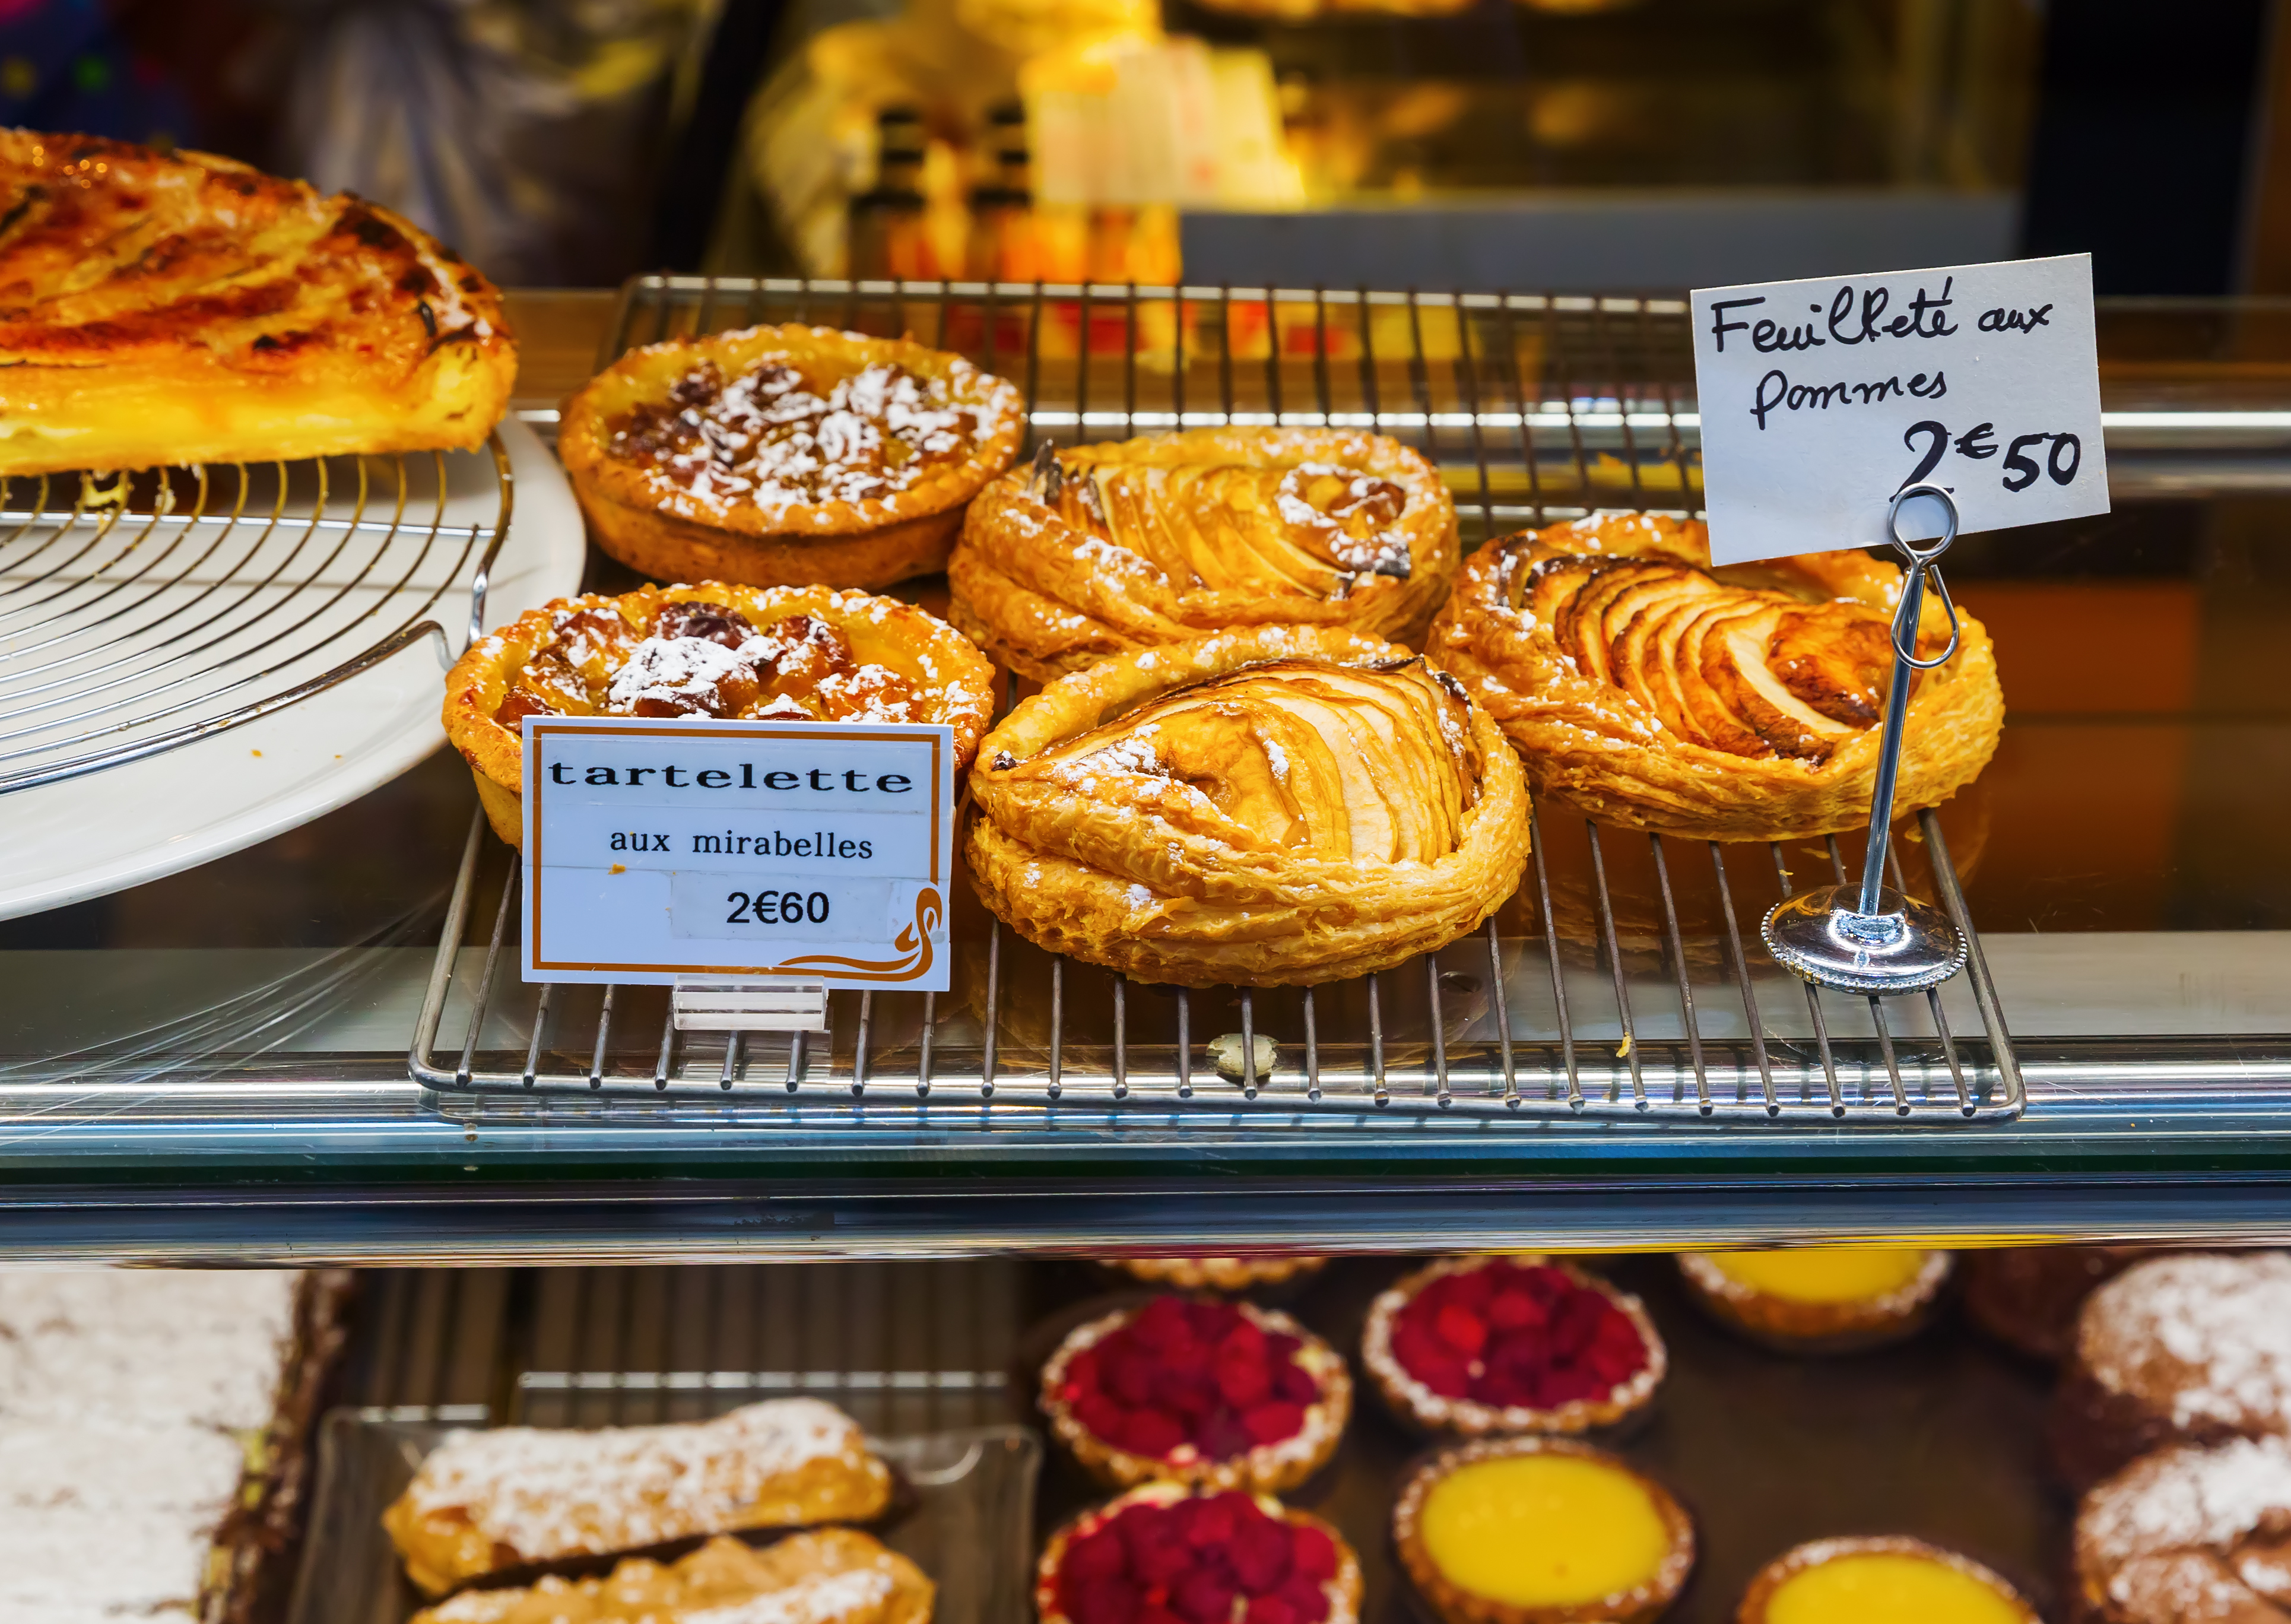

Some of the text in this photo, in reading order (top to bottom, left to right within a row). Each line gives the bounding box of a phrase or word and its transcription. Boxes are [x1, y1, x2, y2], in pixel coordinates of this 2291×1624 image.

[1711, 275, 2053, 353] Feuilleté aux
[548, 762, 913, 793] tartelette
[610, 829, 873, 859] aux mirabelles
[726, 890, 830, 924] 2€60
